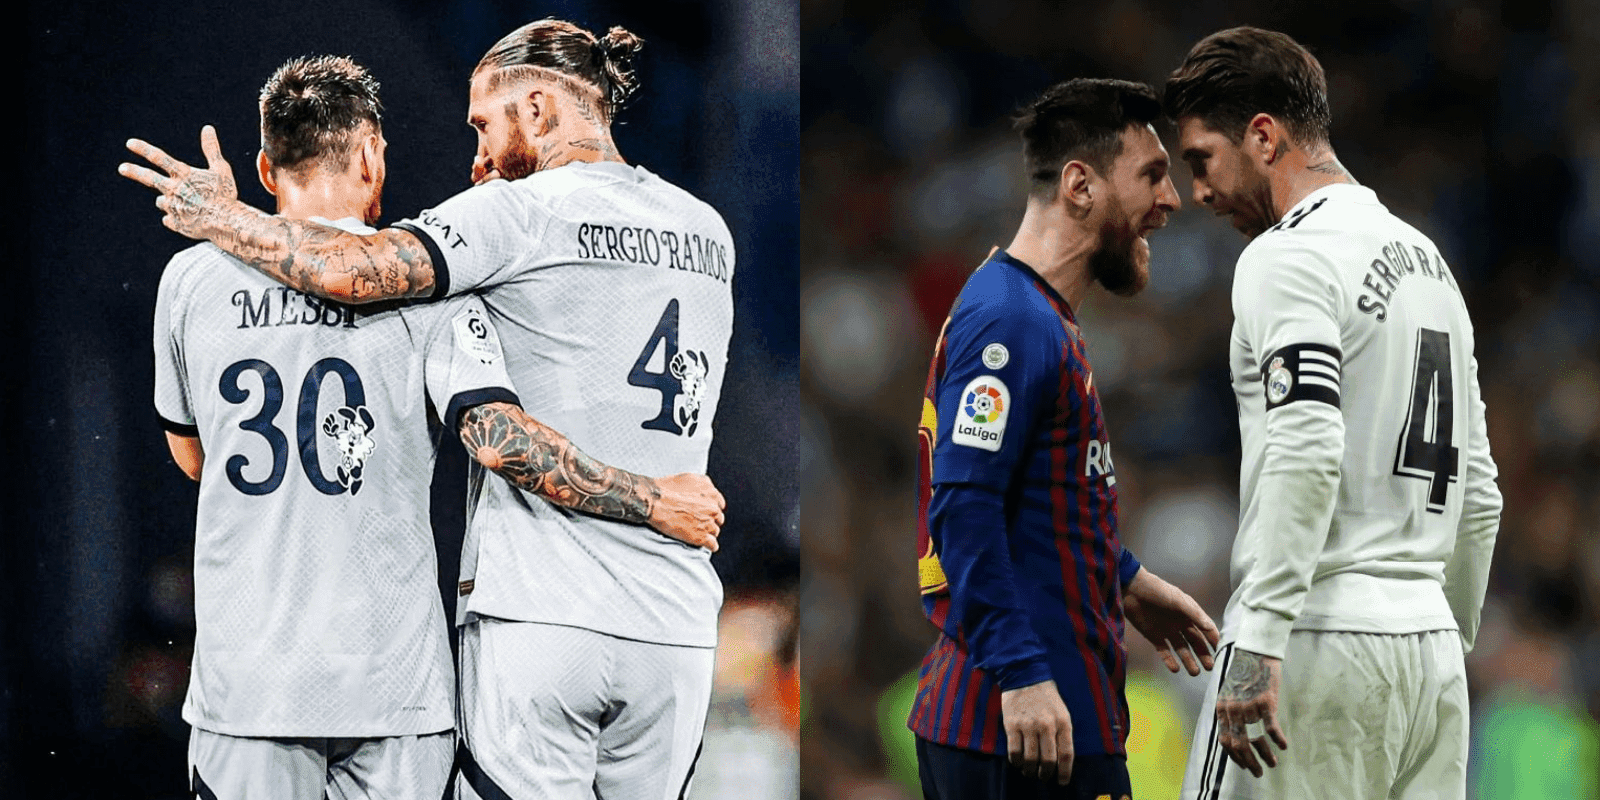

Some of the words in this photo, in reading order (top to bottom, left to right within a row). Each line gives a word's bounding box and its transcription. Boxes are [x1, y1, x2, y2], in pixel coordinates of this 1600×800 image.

[578, 222, 660, 267] SERGIO
[660, 230, 728, 284] RAMOS
[1357, 240, 1416, 323] SERGIO
[627, 298, 685, 436] 4
[1392, 326, 1459, 515] 4
[218, 357, 367, 496] 30
[958, 424, 999, 441] LaLiga
